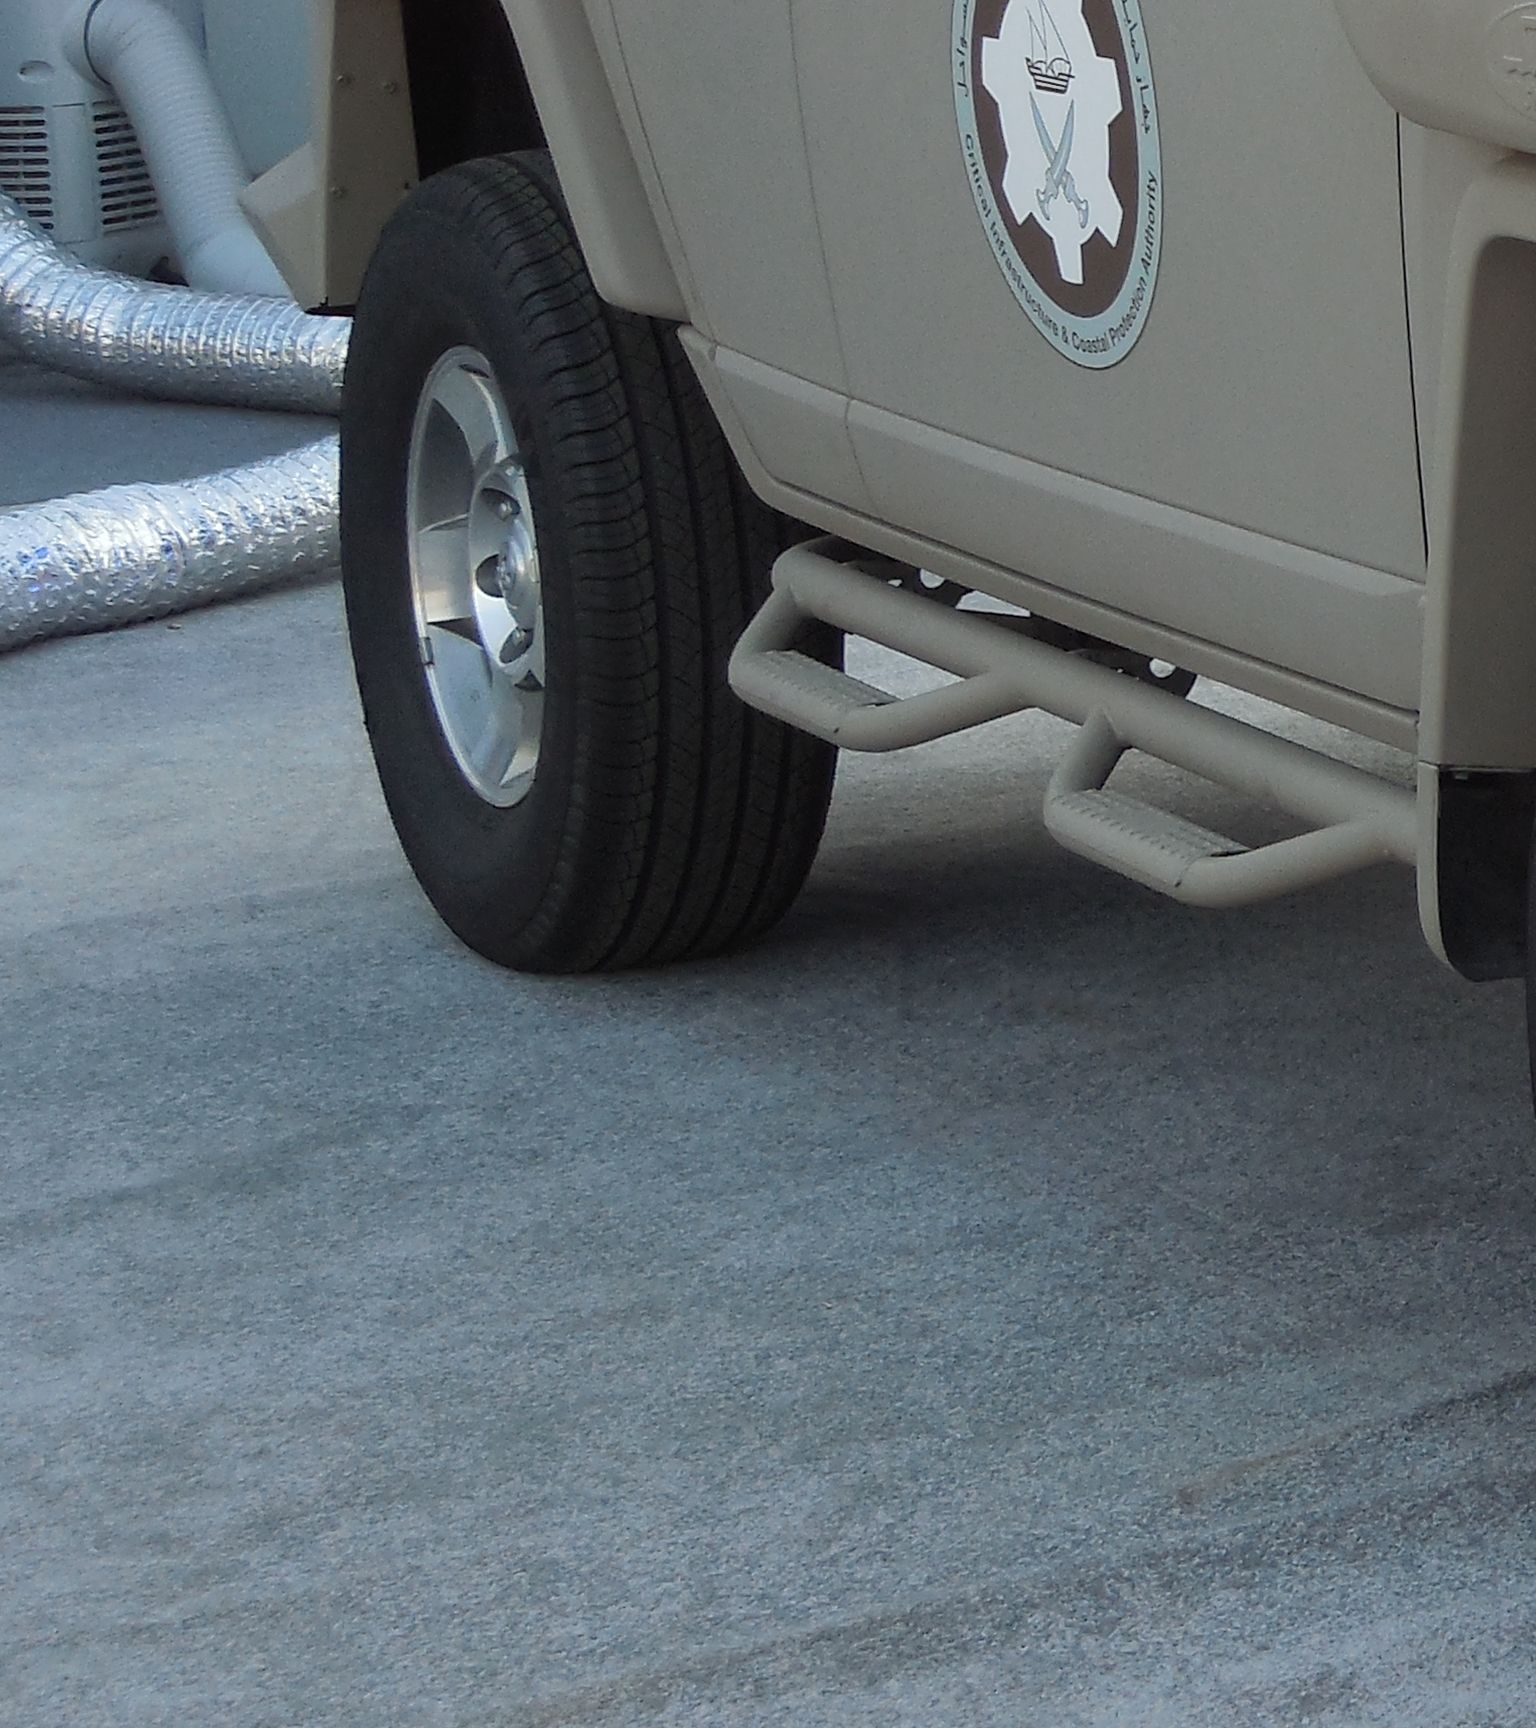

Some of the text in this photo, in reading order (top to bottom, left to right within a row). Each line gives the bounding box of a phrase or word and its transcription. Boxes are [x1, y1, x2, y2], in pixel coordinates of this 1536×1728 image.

[964, 133, 1159, 354] Critical Infrastructure & Coastal Protection Authority
